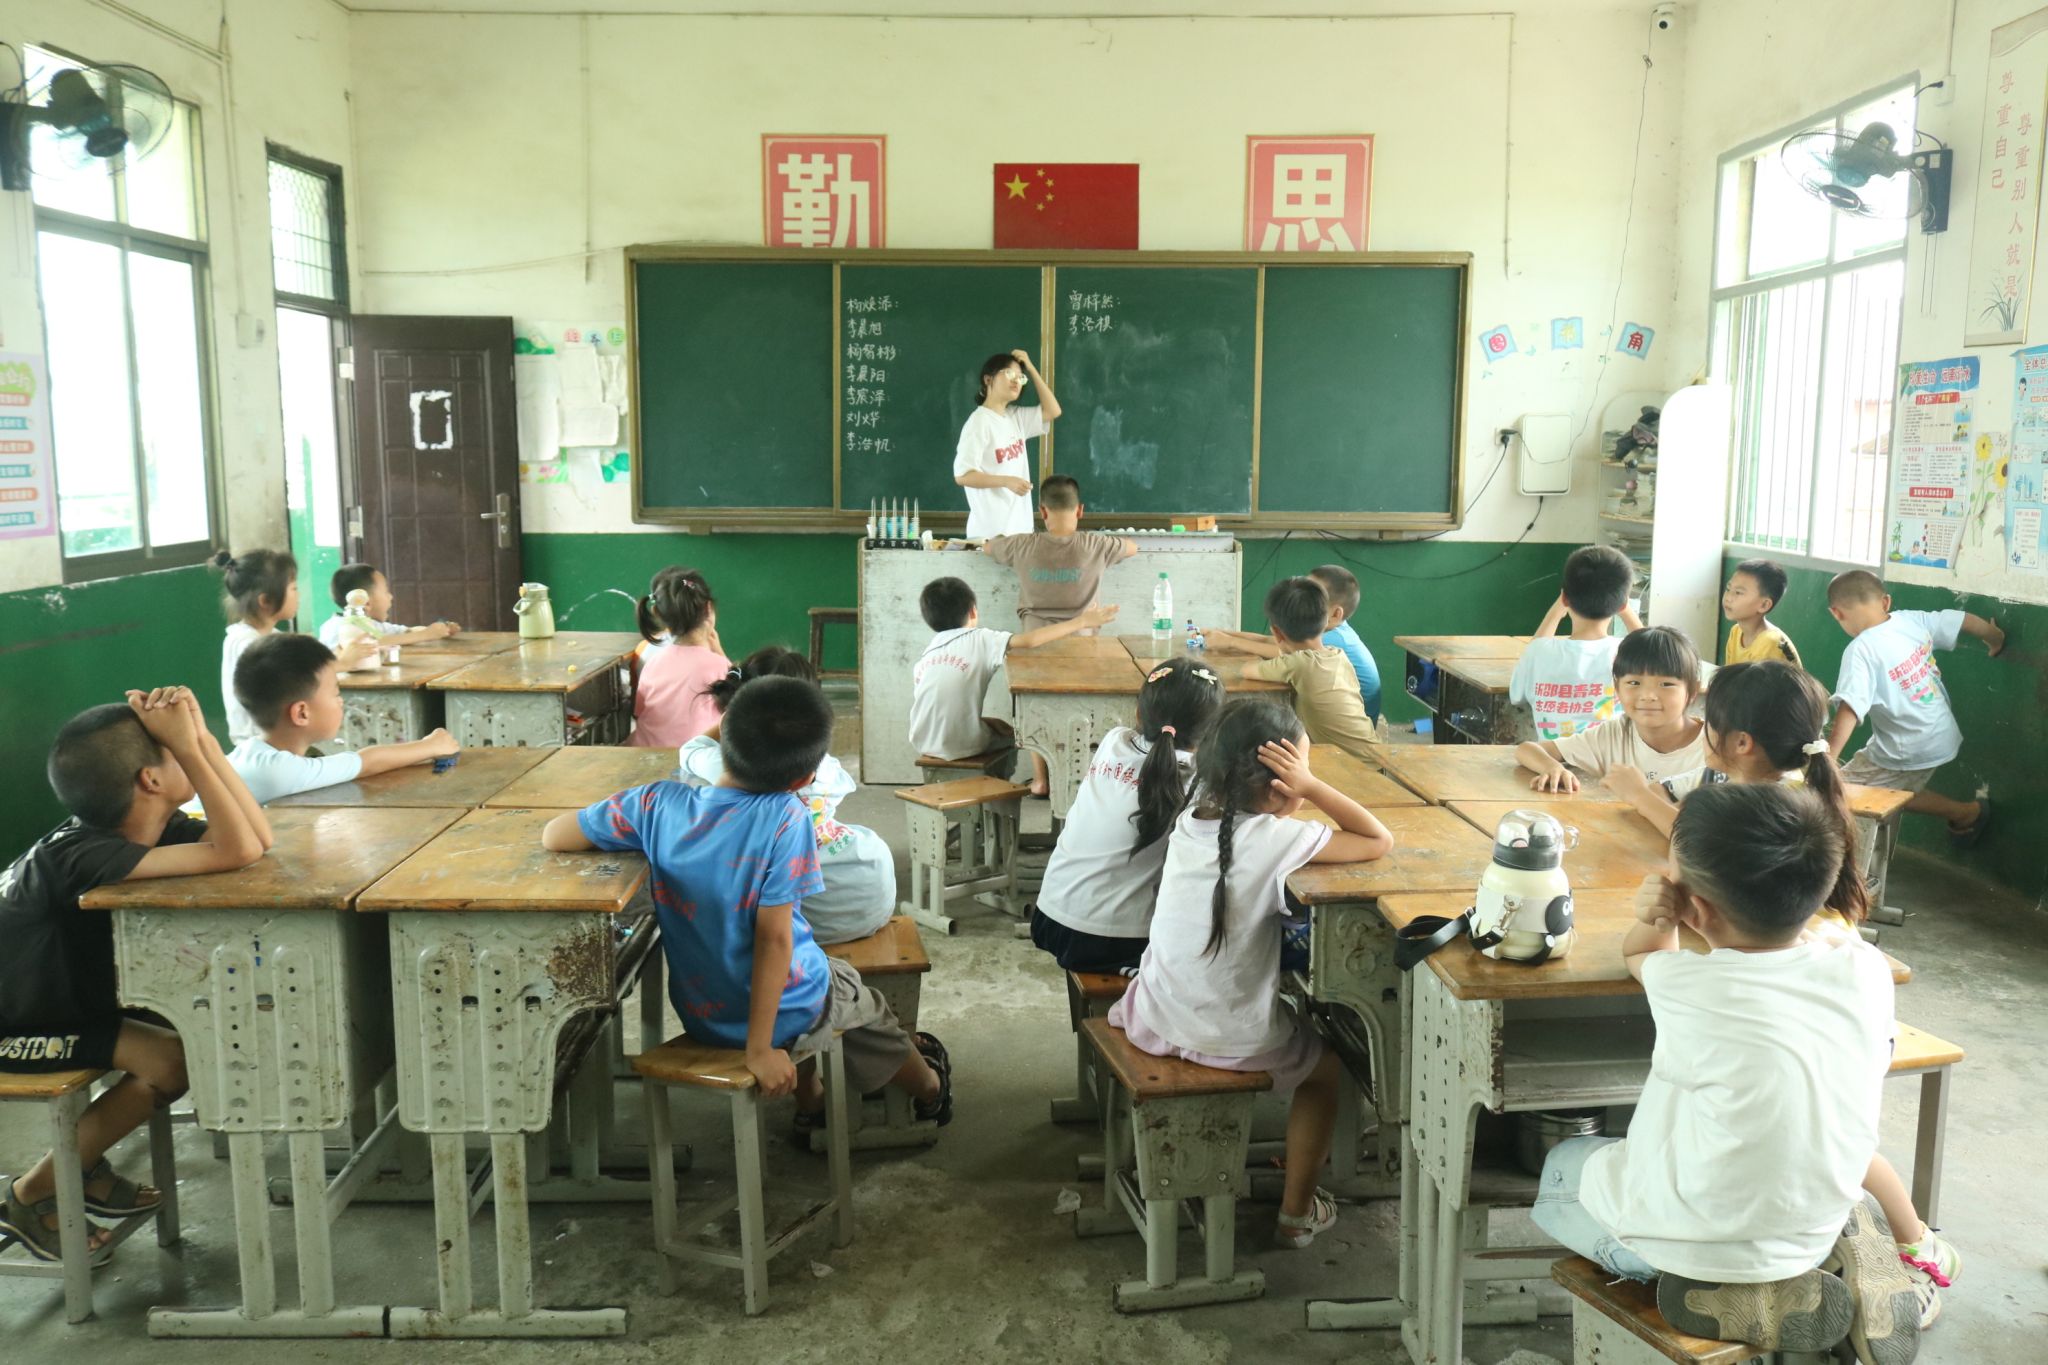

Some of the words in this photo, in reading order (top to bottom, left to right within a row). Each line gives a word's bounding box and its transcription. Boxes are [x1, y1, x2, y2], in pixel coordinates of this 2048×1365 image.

[1990, 70, 2015, 191] 尊重自己
[777, 153, 872, 249] 勤
[1259, 153, 1356, 252] 思
[2003, 112, 2033, 299] 尊重别人就是
[1626, 331, 1645, 352] 角
[1535, 700, 1594, 714] 志愿者协会
